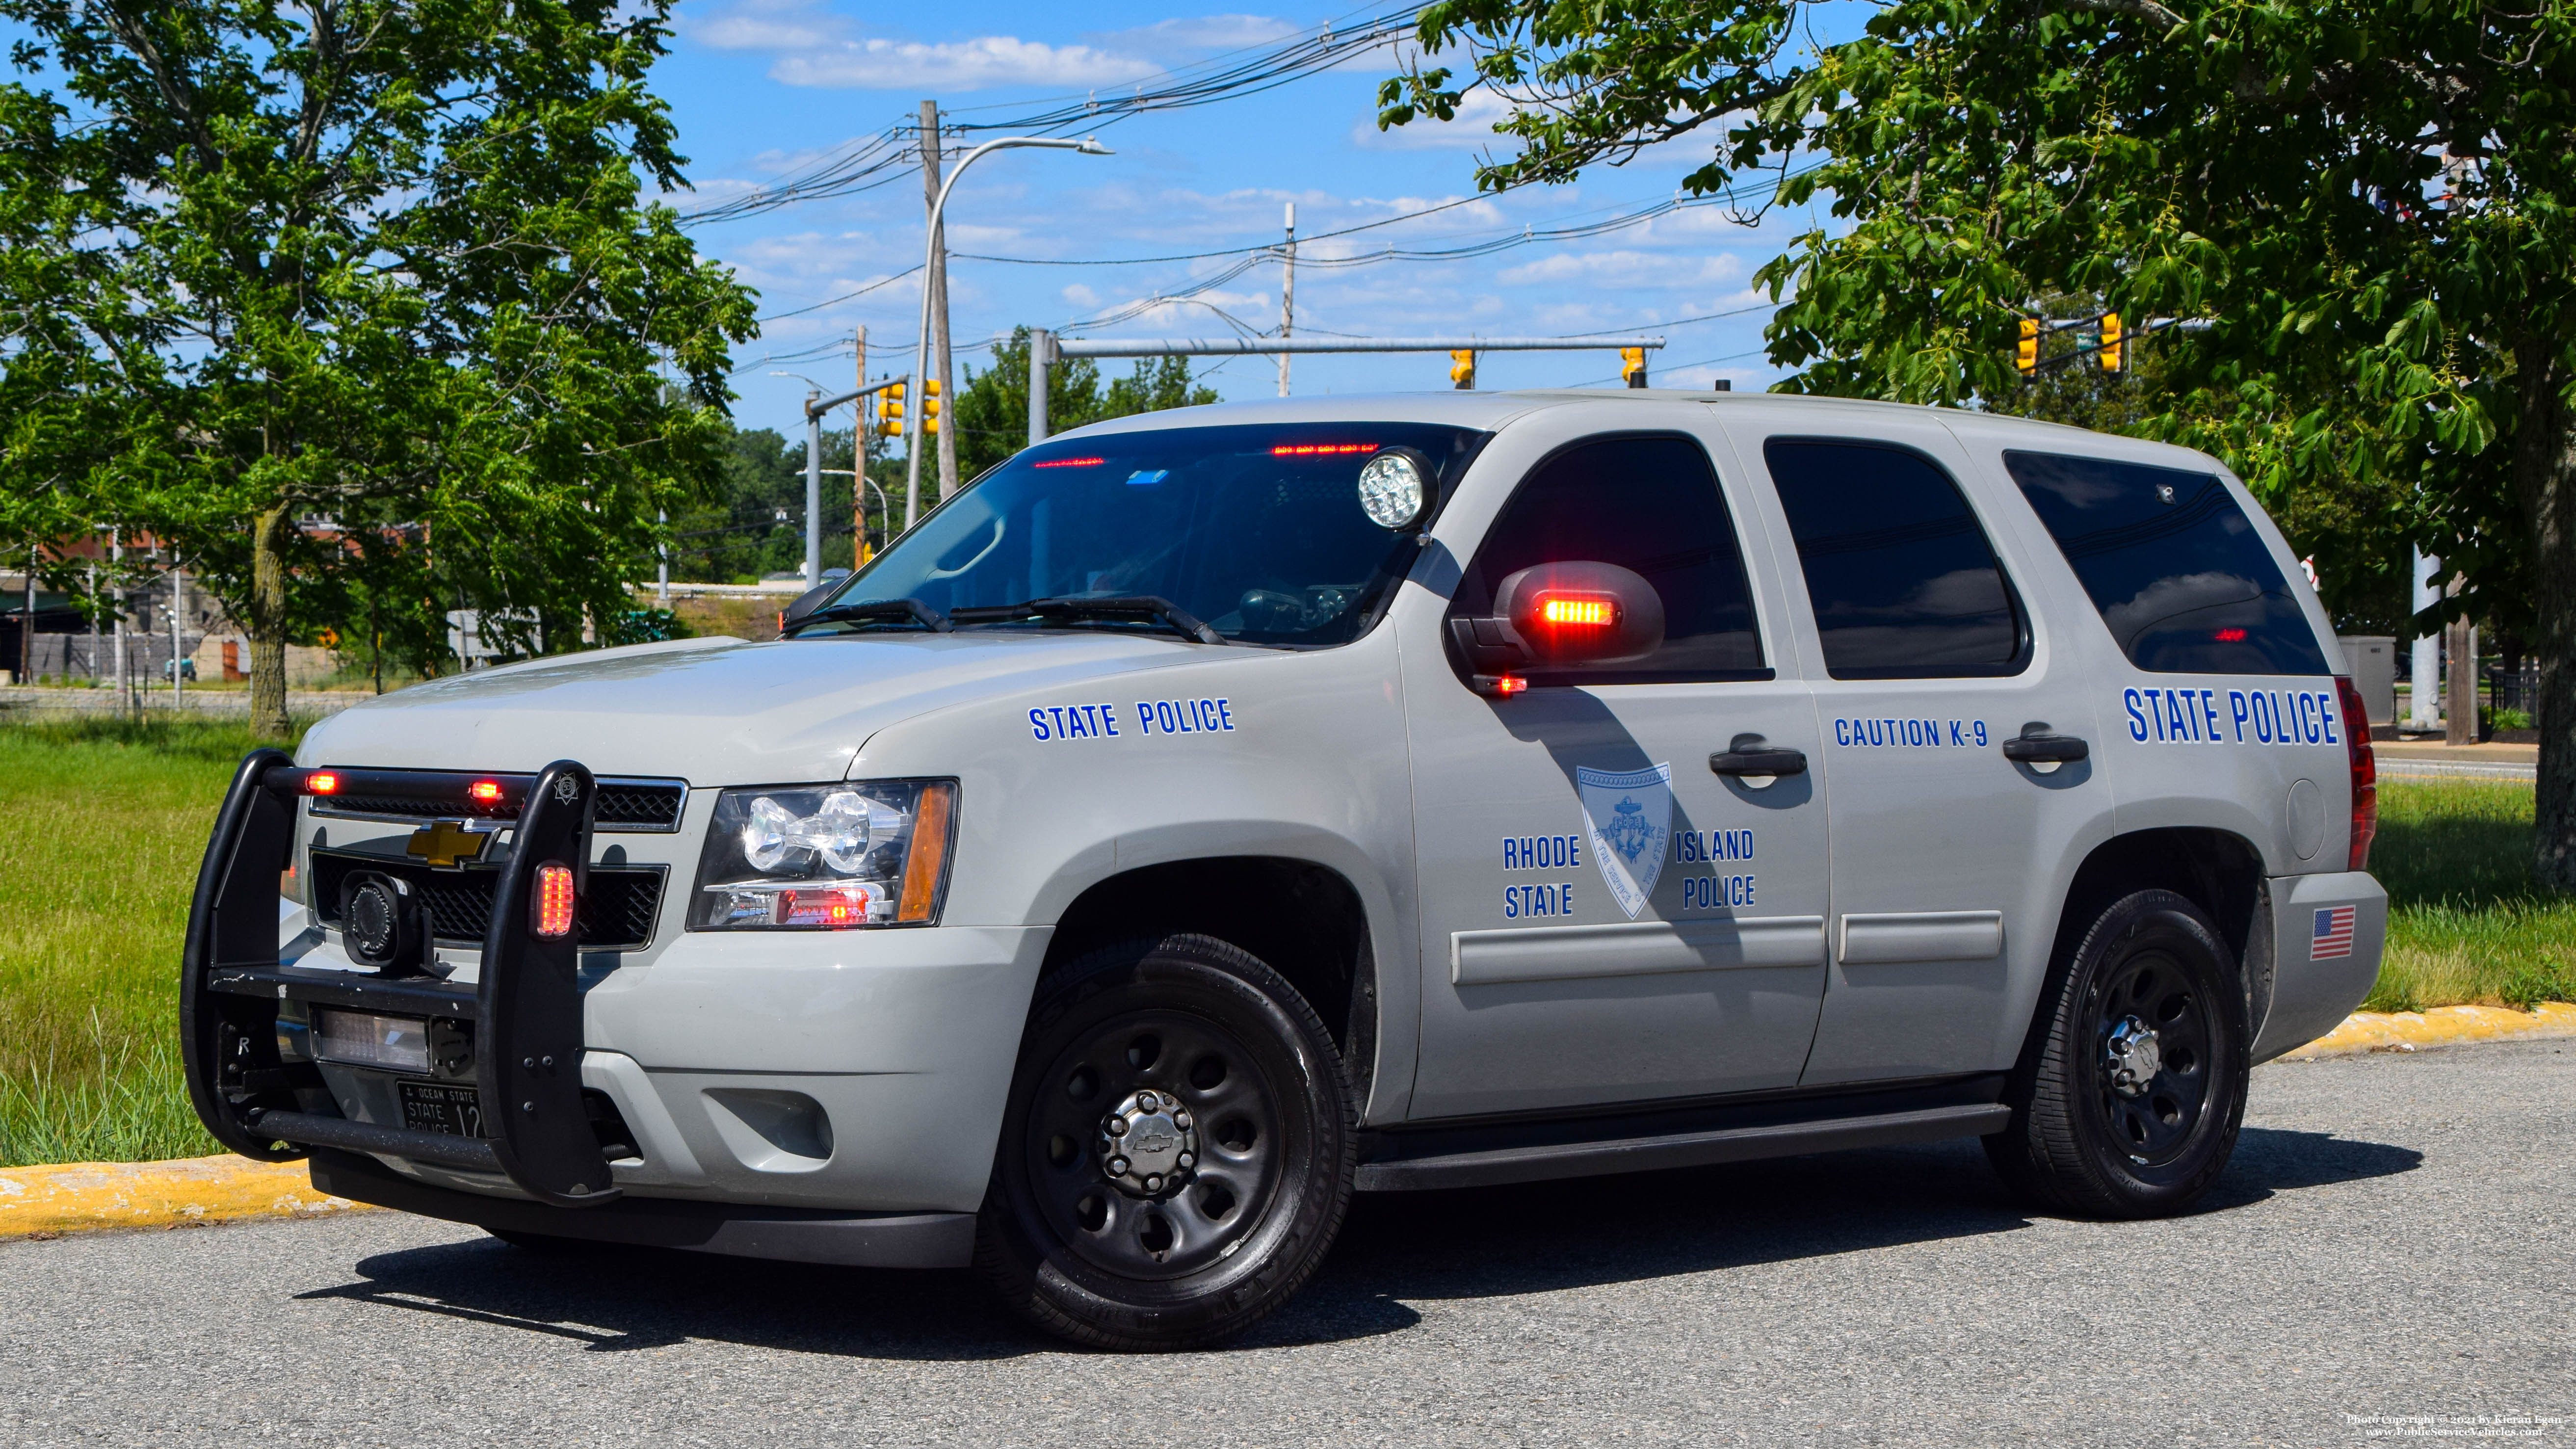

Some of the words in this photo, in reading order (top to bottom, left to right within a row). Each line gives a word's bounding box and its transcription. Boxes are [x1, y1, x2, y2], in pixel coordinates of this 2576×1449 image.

[1028, 703, 1121, 742] STATE
[1135, 697, 1235, 736] POLICE
[1834, 718, 1941, 747] CAUTION
[1949, 718, 1988, 748] K-9
[2122, 687, 2222, 745] STATE
[2227, 688, 2339, 746] POLICE
[1502, 835, 1580, 870] RHODE
[1676, 829, 1754, 864] ISLAND
[1504, 883, 1573, 919] STATE
[1683, 875, 1755, 909] POLICE
[238, 1037, 250, 1055] R
[408, 1102, 445, 1120] STATE
[419, 1088, 444, 1100] OCEAN
[449, 1090, 475, 1103] STATE
